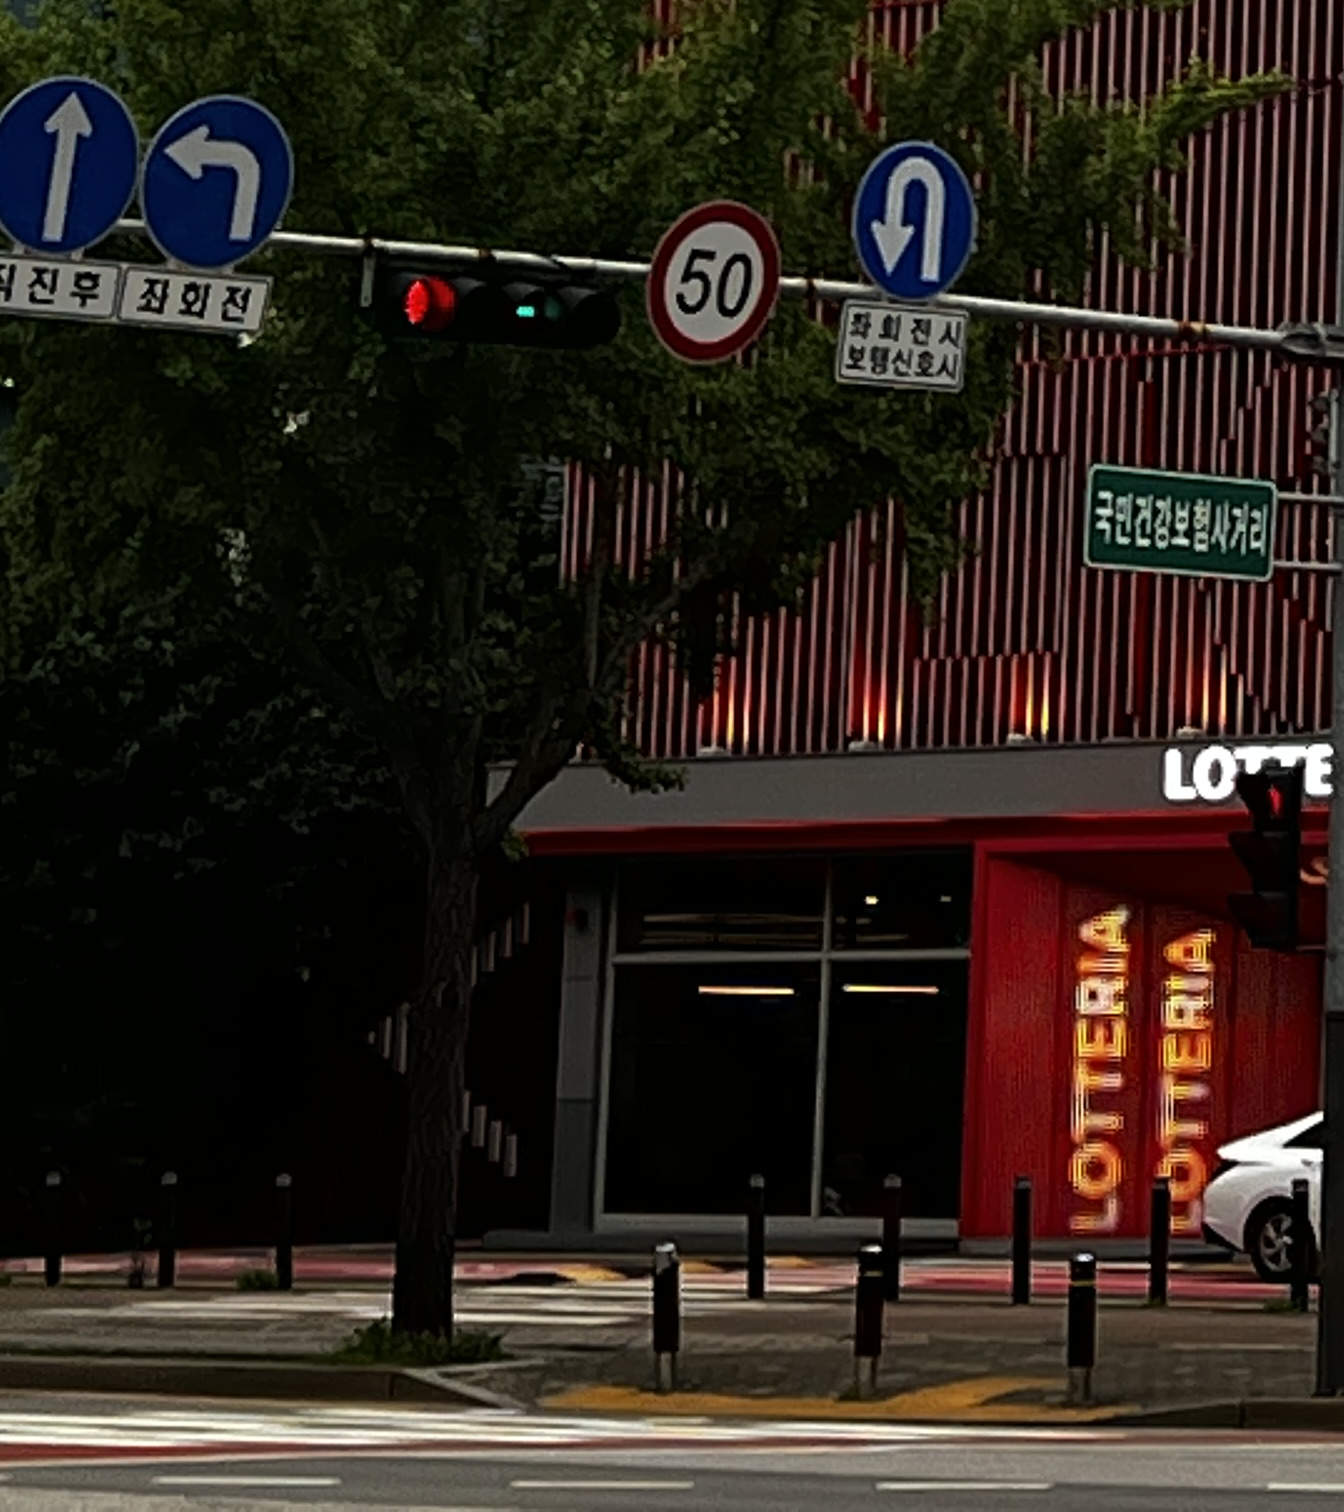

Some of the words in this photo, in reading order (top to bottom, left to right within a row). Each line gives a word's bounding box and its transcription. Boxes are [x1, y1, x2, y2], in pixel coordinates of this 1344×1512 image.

[136, 278, 252, 324] 좌회전
[675, 248, 754, 318] 50
[844, 345, 959, 378] 보행신호시
[1094, 490, 1269, 557] 국민건강보험사거리
[1069, 904, 1131, 1235] LOTTERIA
